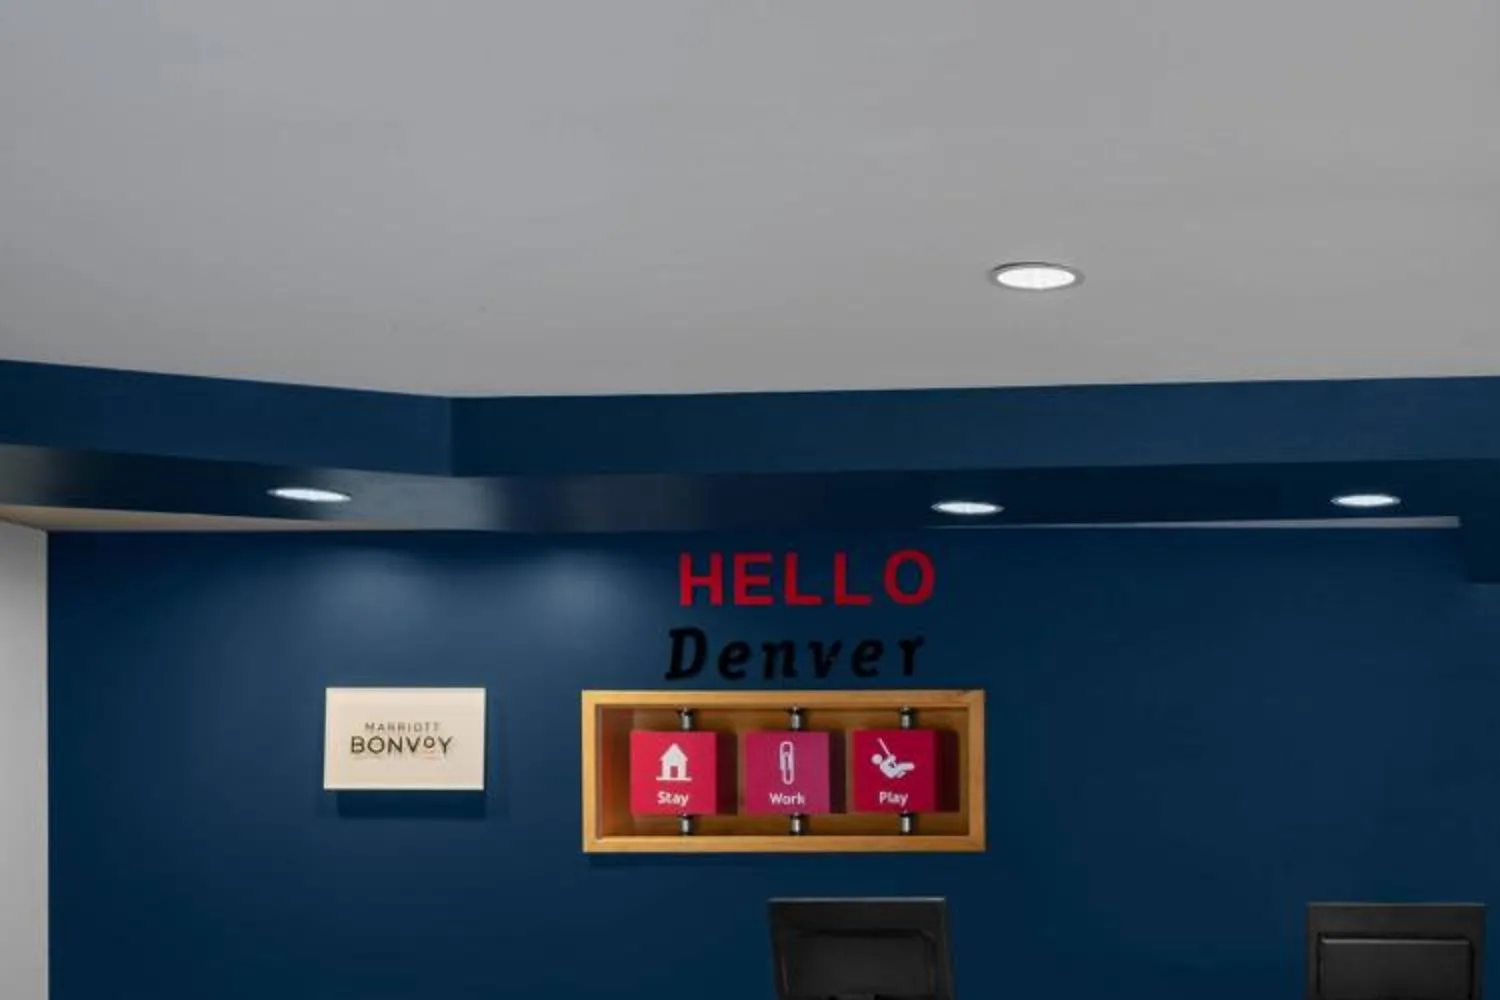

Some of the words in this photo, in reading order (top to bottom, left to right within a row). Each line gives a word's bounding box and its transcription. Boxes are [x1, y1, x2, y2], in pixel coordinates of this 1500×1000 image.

[678, 549, 936, 606] HELLO
[664, 626, 926, 681] Denver
[364, 722, 441, 733] MARRIOTT
[657, 790, 690, 807] Stay
[768, 791, 805, 806] Work
[878, 790, 909, 807] Play
